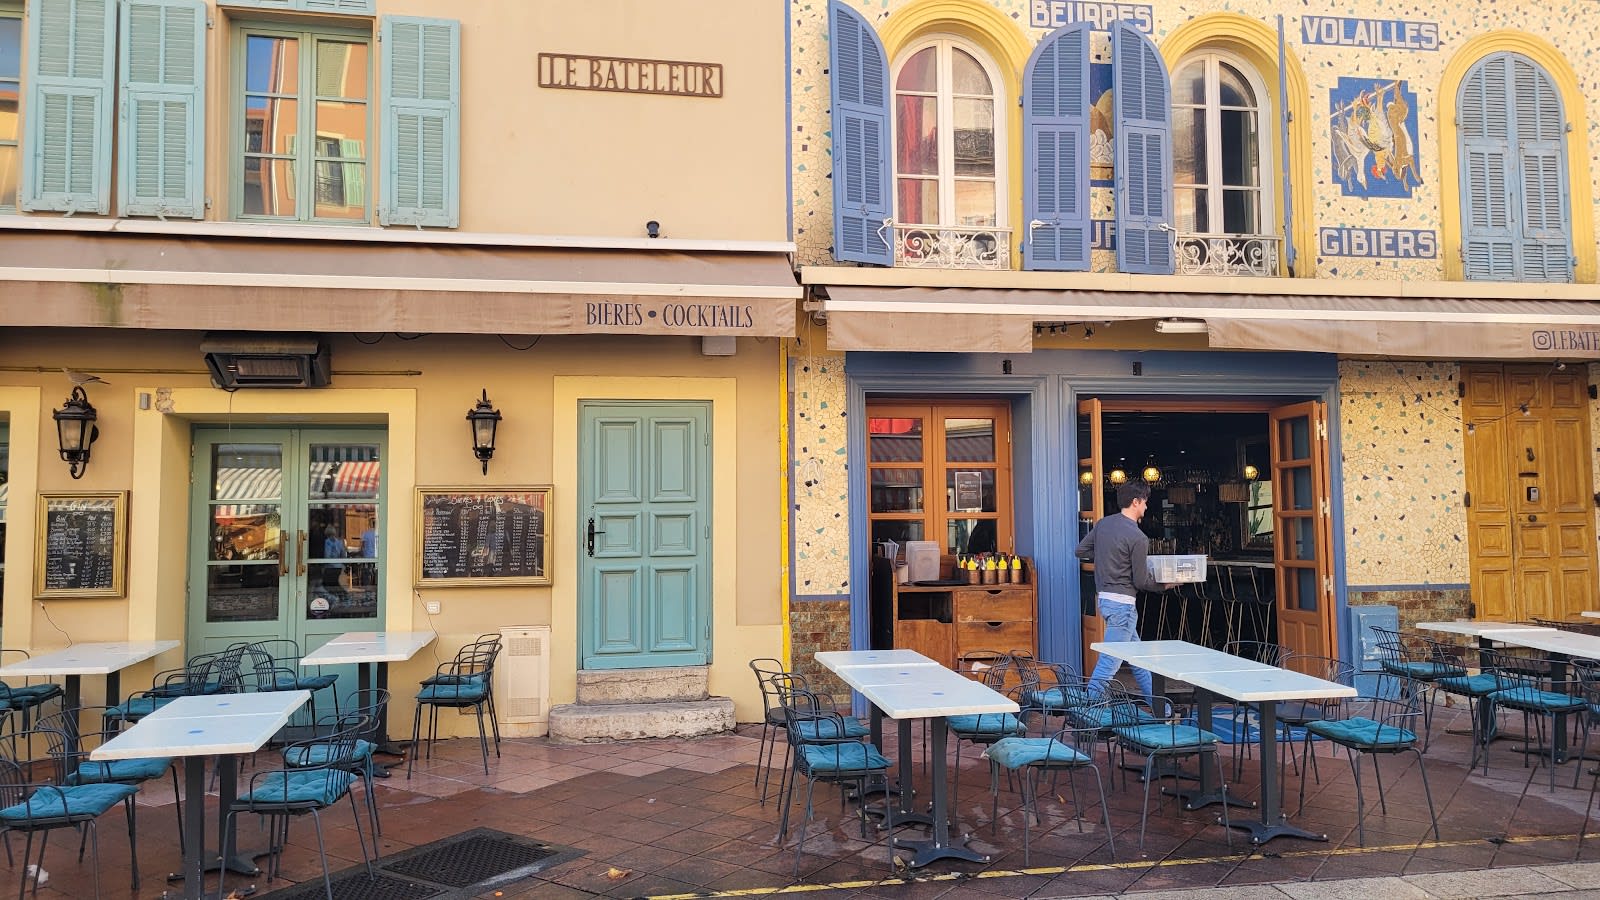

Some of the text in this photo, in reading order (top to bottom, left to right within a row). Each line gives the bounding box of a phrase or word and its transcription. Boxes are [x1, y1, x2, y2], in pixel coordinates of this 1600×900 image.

[1302, 17, 1438, 49] VOLAILLES
[550, 55, 718, 97] LE BATELEUR
[1321, 229, 1435, 257] GIBIERS
[586, 300, 753, 328] BIÈRES COCKTAILS
